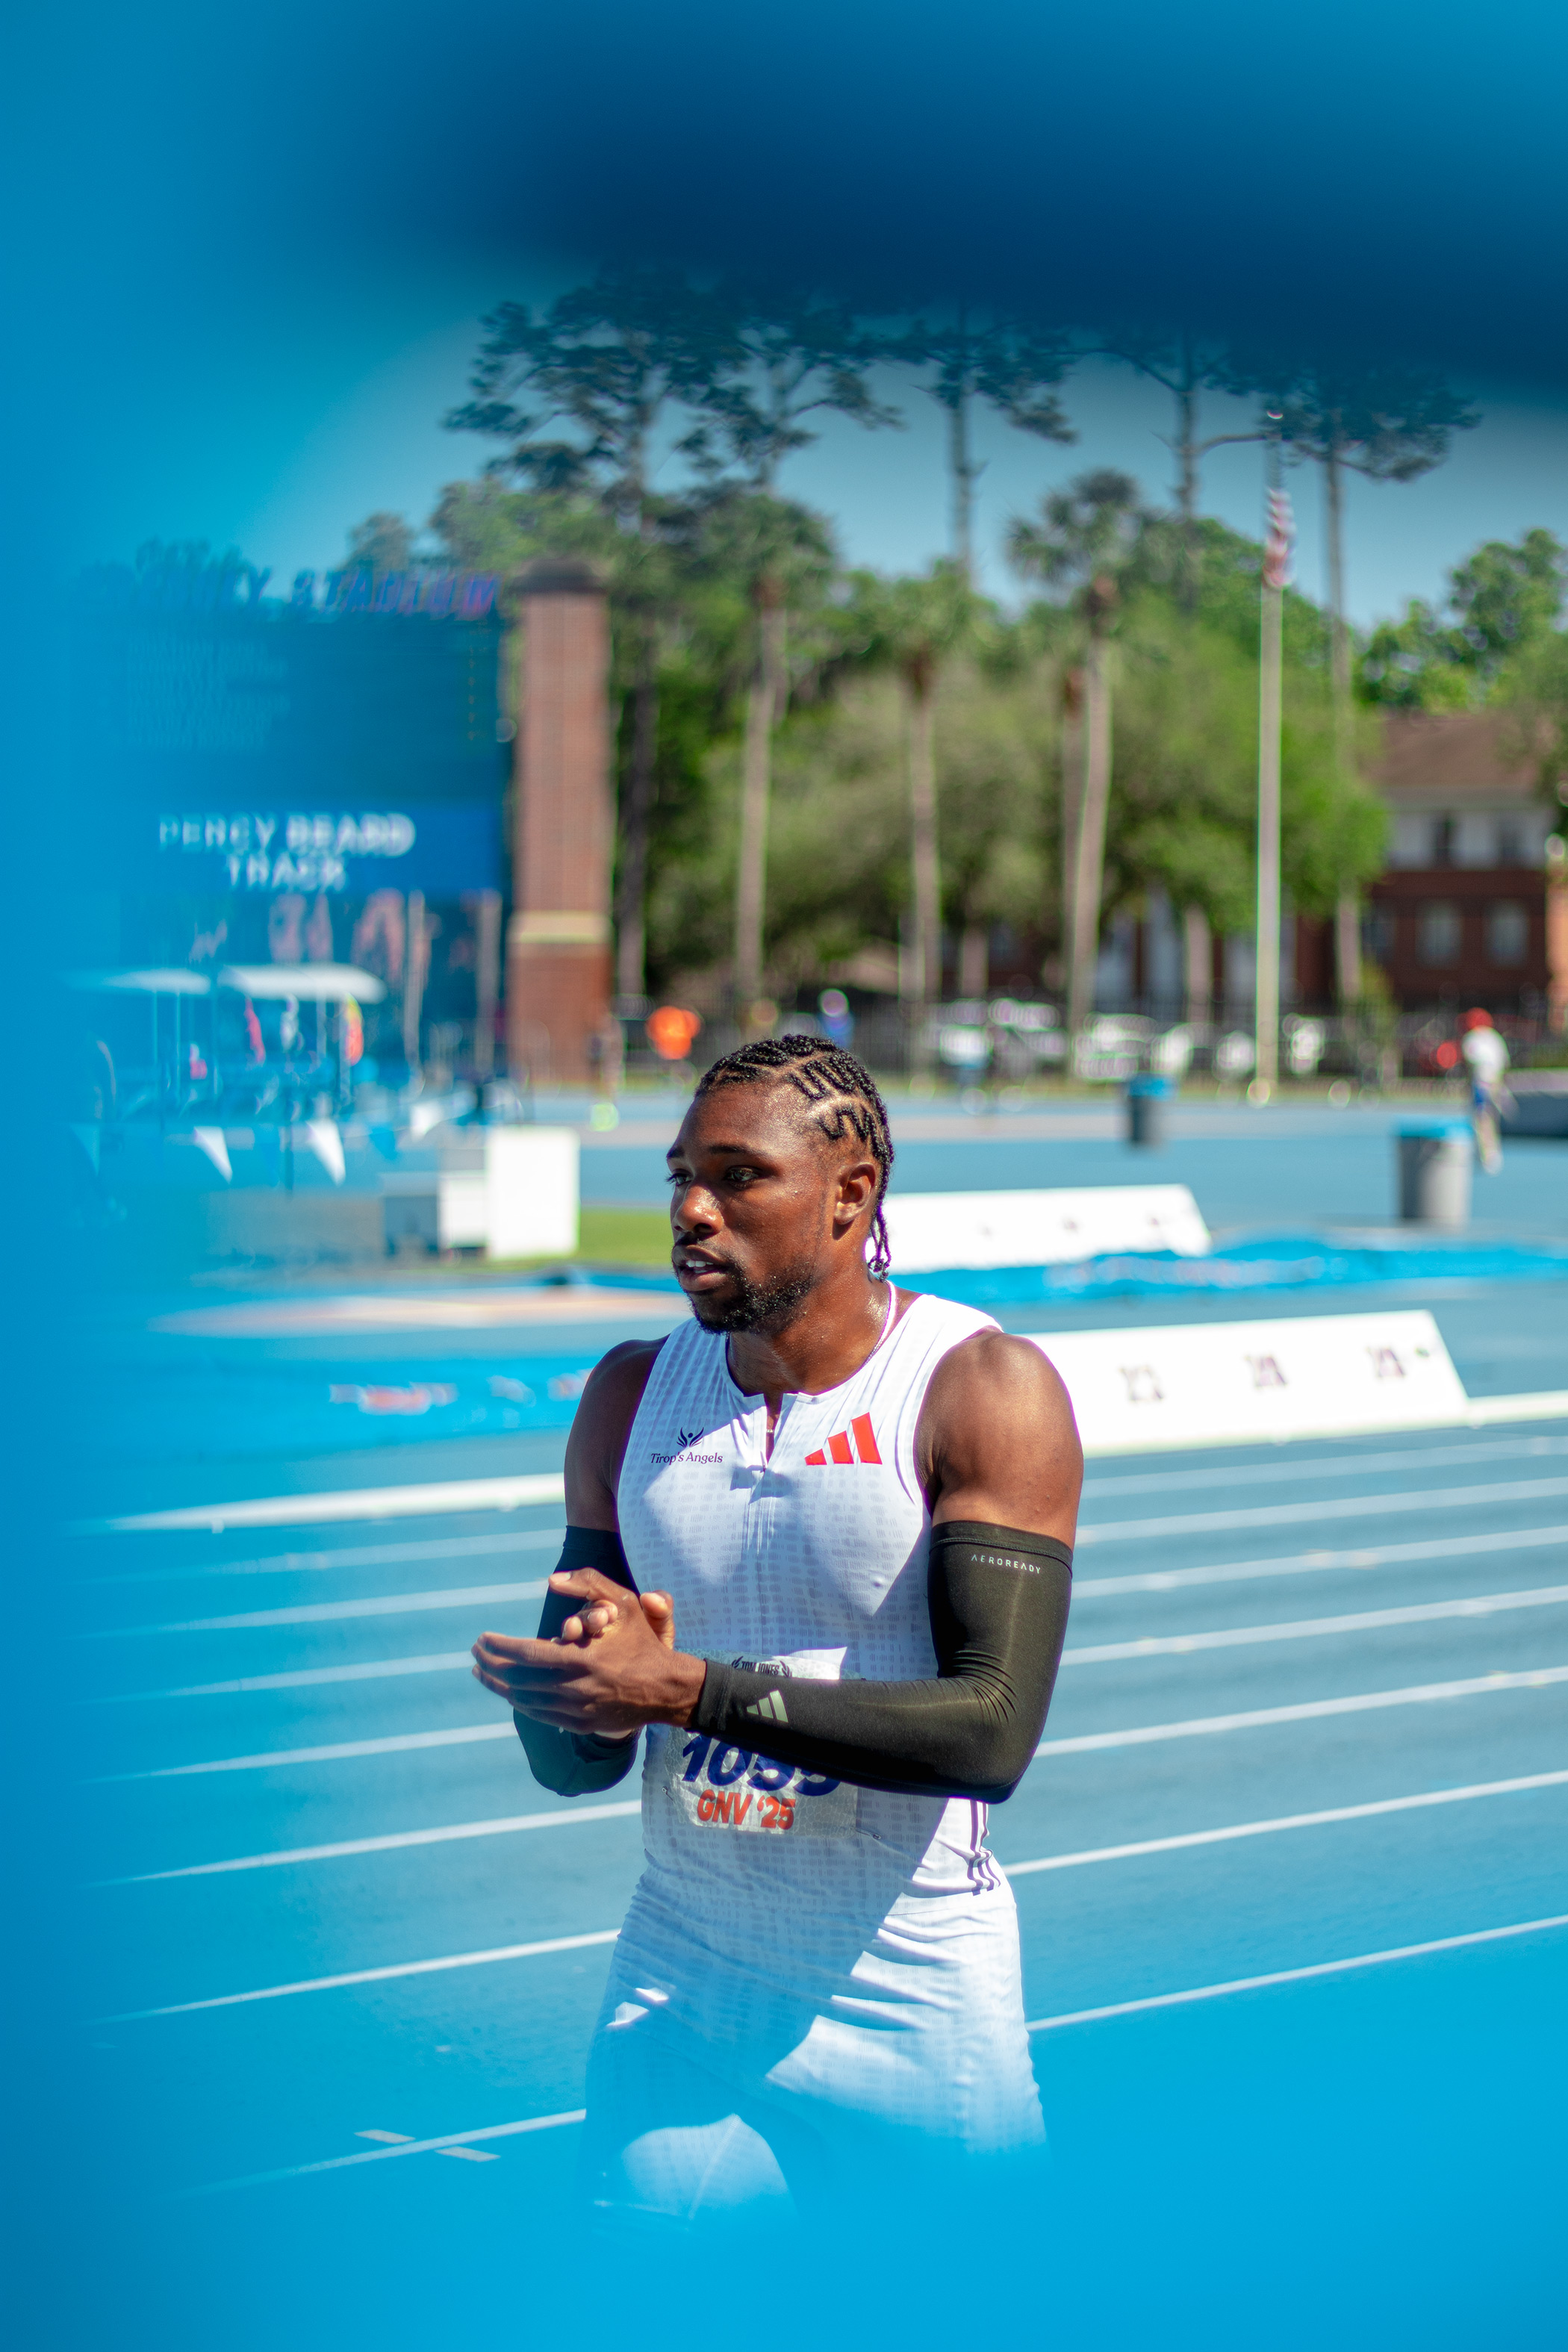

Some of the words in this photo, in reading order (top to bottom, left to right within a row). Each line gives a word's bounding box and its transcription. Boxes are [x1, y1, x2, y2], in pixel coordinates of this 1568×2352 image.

[159, 814, 278, 853] PERCY
[284, 813, 416, 856] BEARD
[226, 852, 349, 892] TRACK
[650, 1452, 684, 1466] Tirop's
[685, 1452, 723, 1464] Angels
[971, 1554, 1040, 1574] AEROREADY
[741, 1661, 756, 1673] TOM
[757, 1662, 780, 1676] JONES
[697, 1789, 753, 1825] GNV
